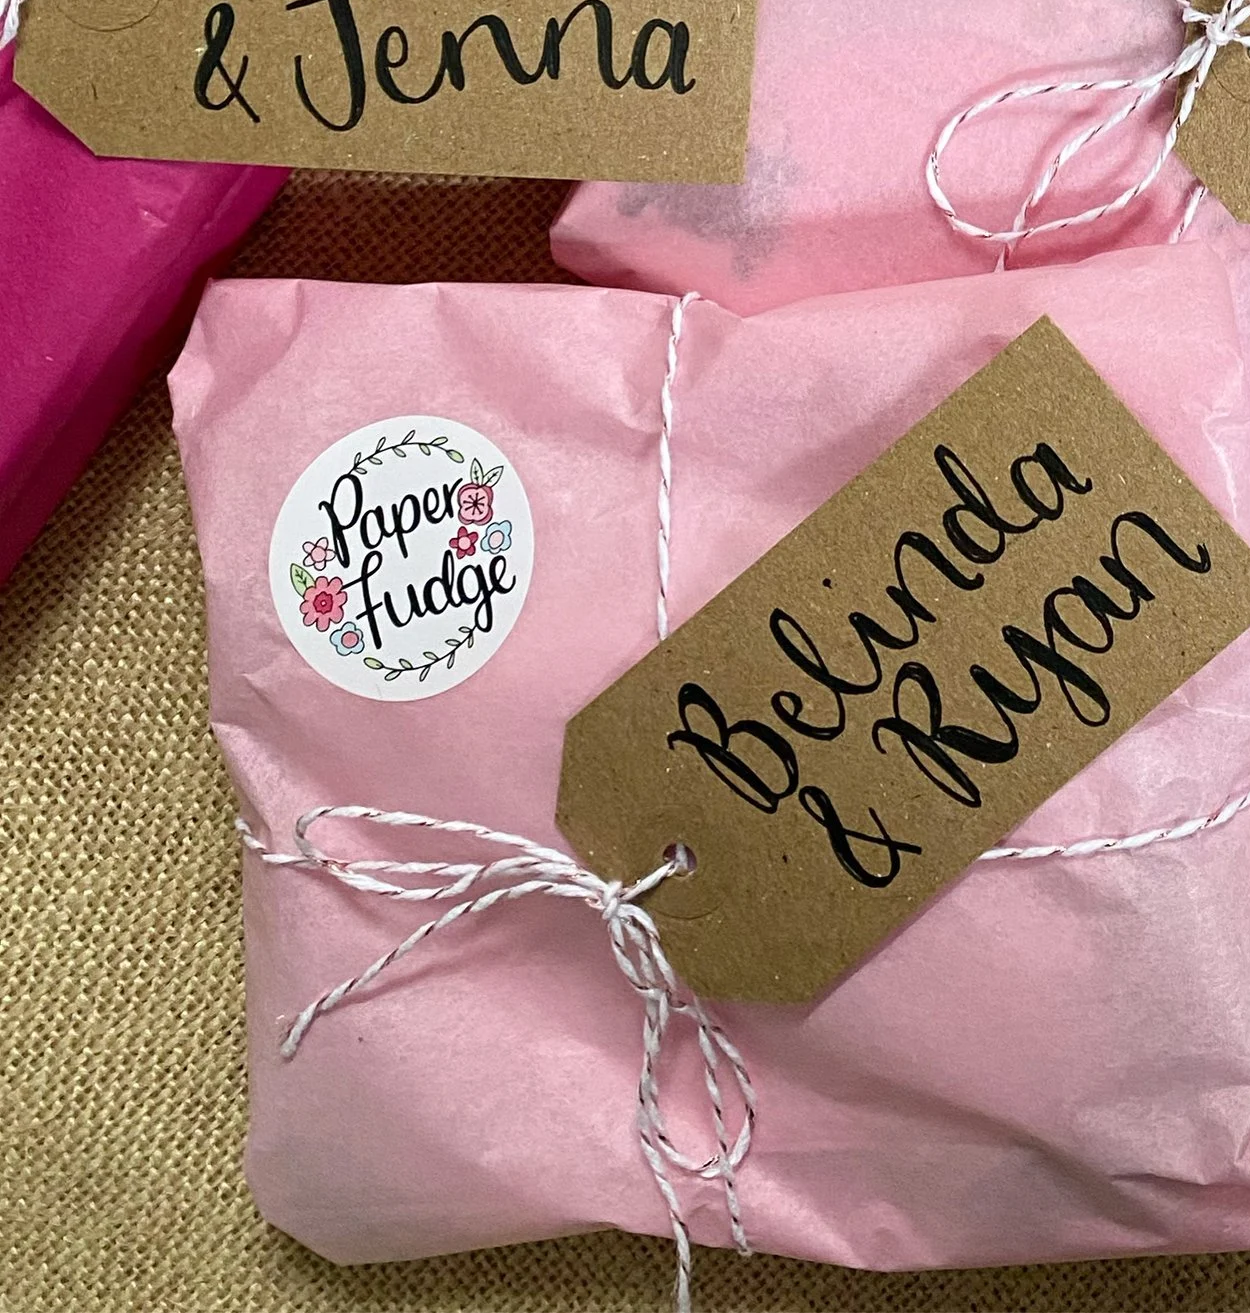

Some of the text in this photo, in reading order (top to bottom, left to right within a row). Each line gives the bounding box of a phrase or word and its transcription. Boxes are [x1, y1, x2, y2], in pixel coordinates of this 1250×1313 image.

[194, 3, 261, 123] &
[319, 474, 463, 568] Paper
[668, 443, 1093, 814] Belinda
[799, 511, 1211, 888] & Ryan
